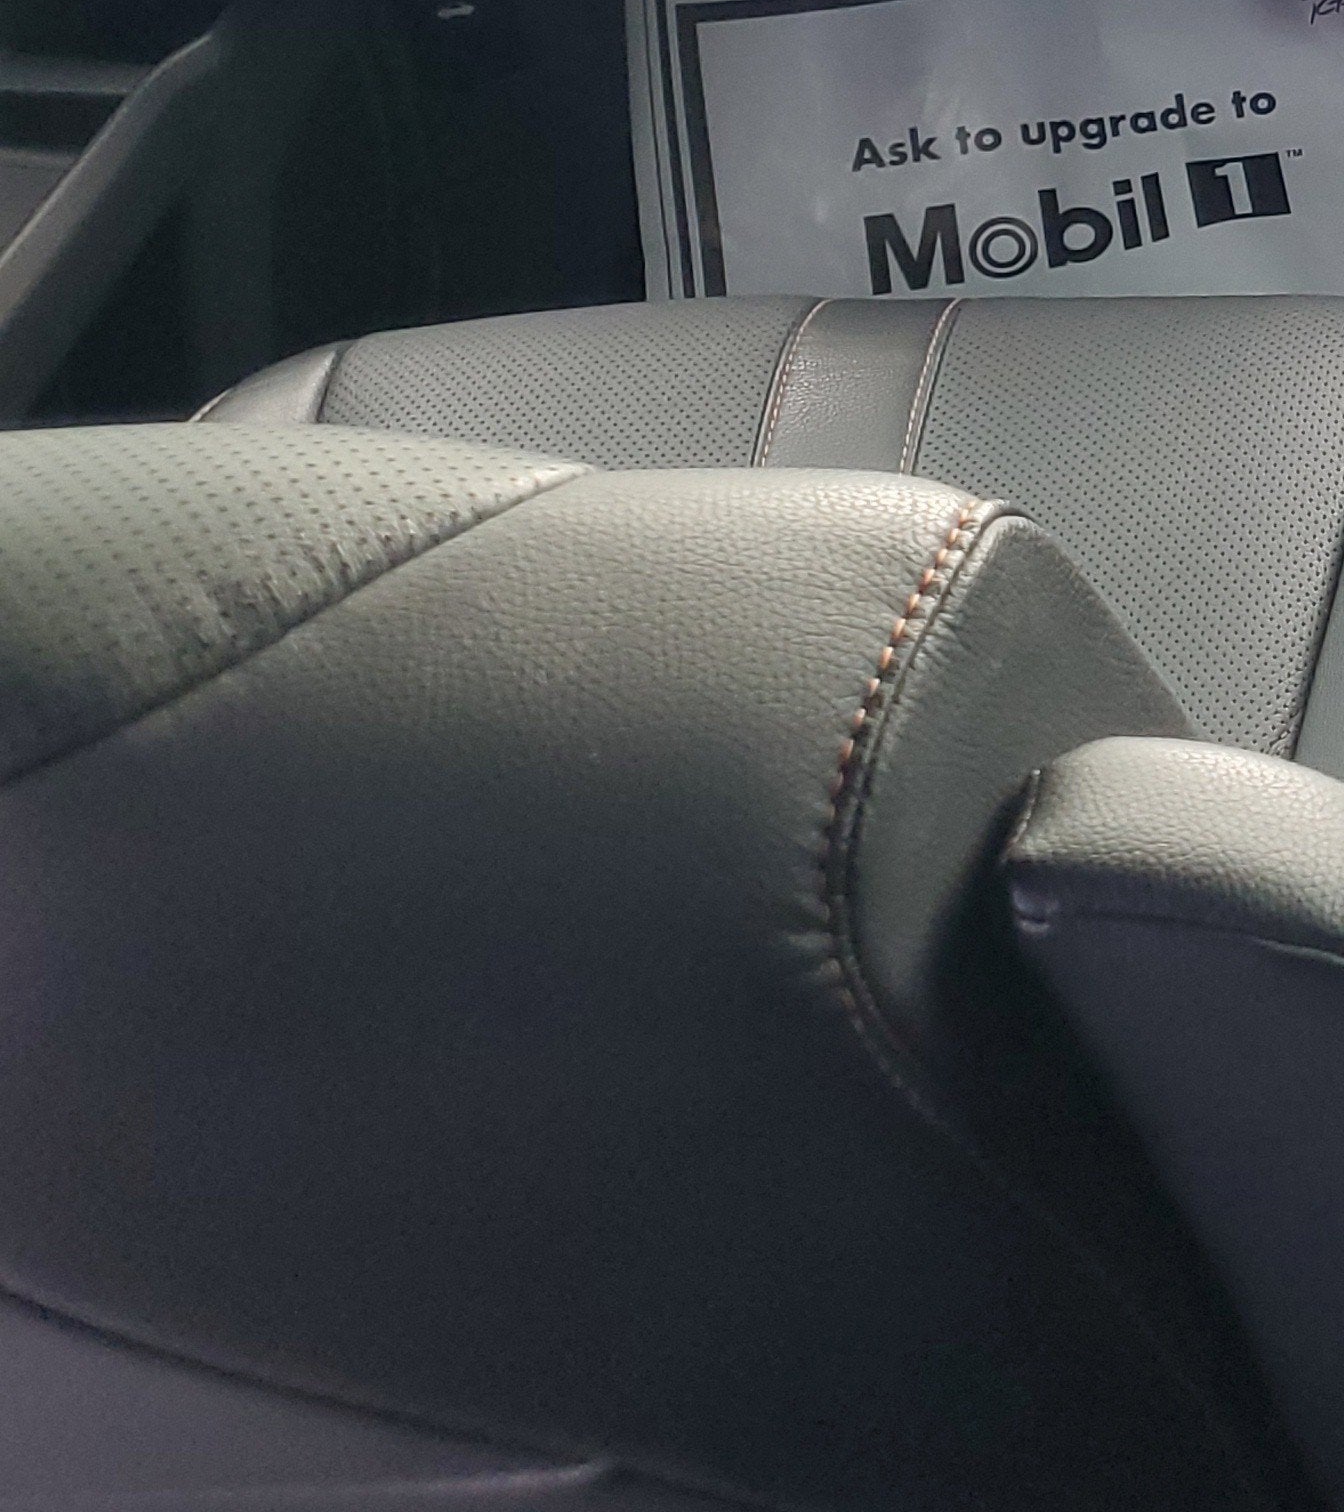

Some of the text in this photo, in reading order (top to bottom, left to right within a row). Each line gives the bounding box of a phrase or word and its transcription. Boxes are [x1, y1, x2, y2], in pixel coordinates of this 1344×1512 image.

[852, 90, 1277, 173] Ask to upgrade to
[863, 171, 1170, 296] Mobil
